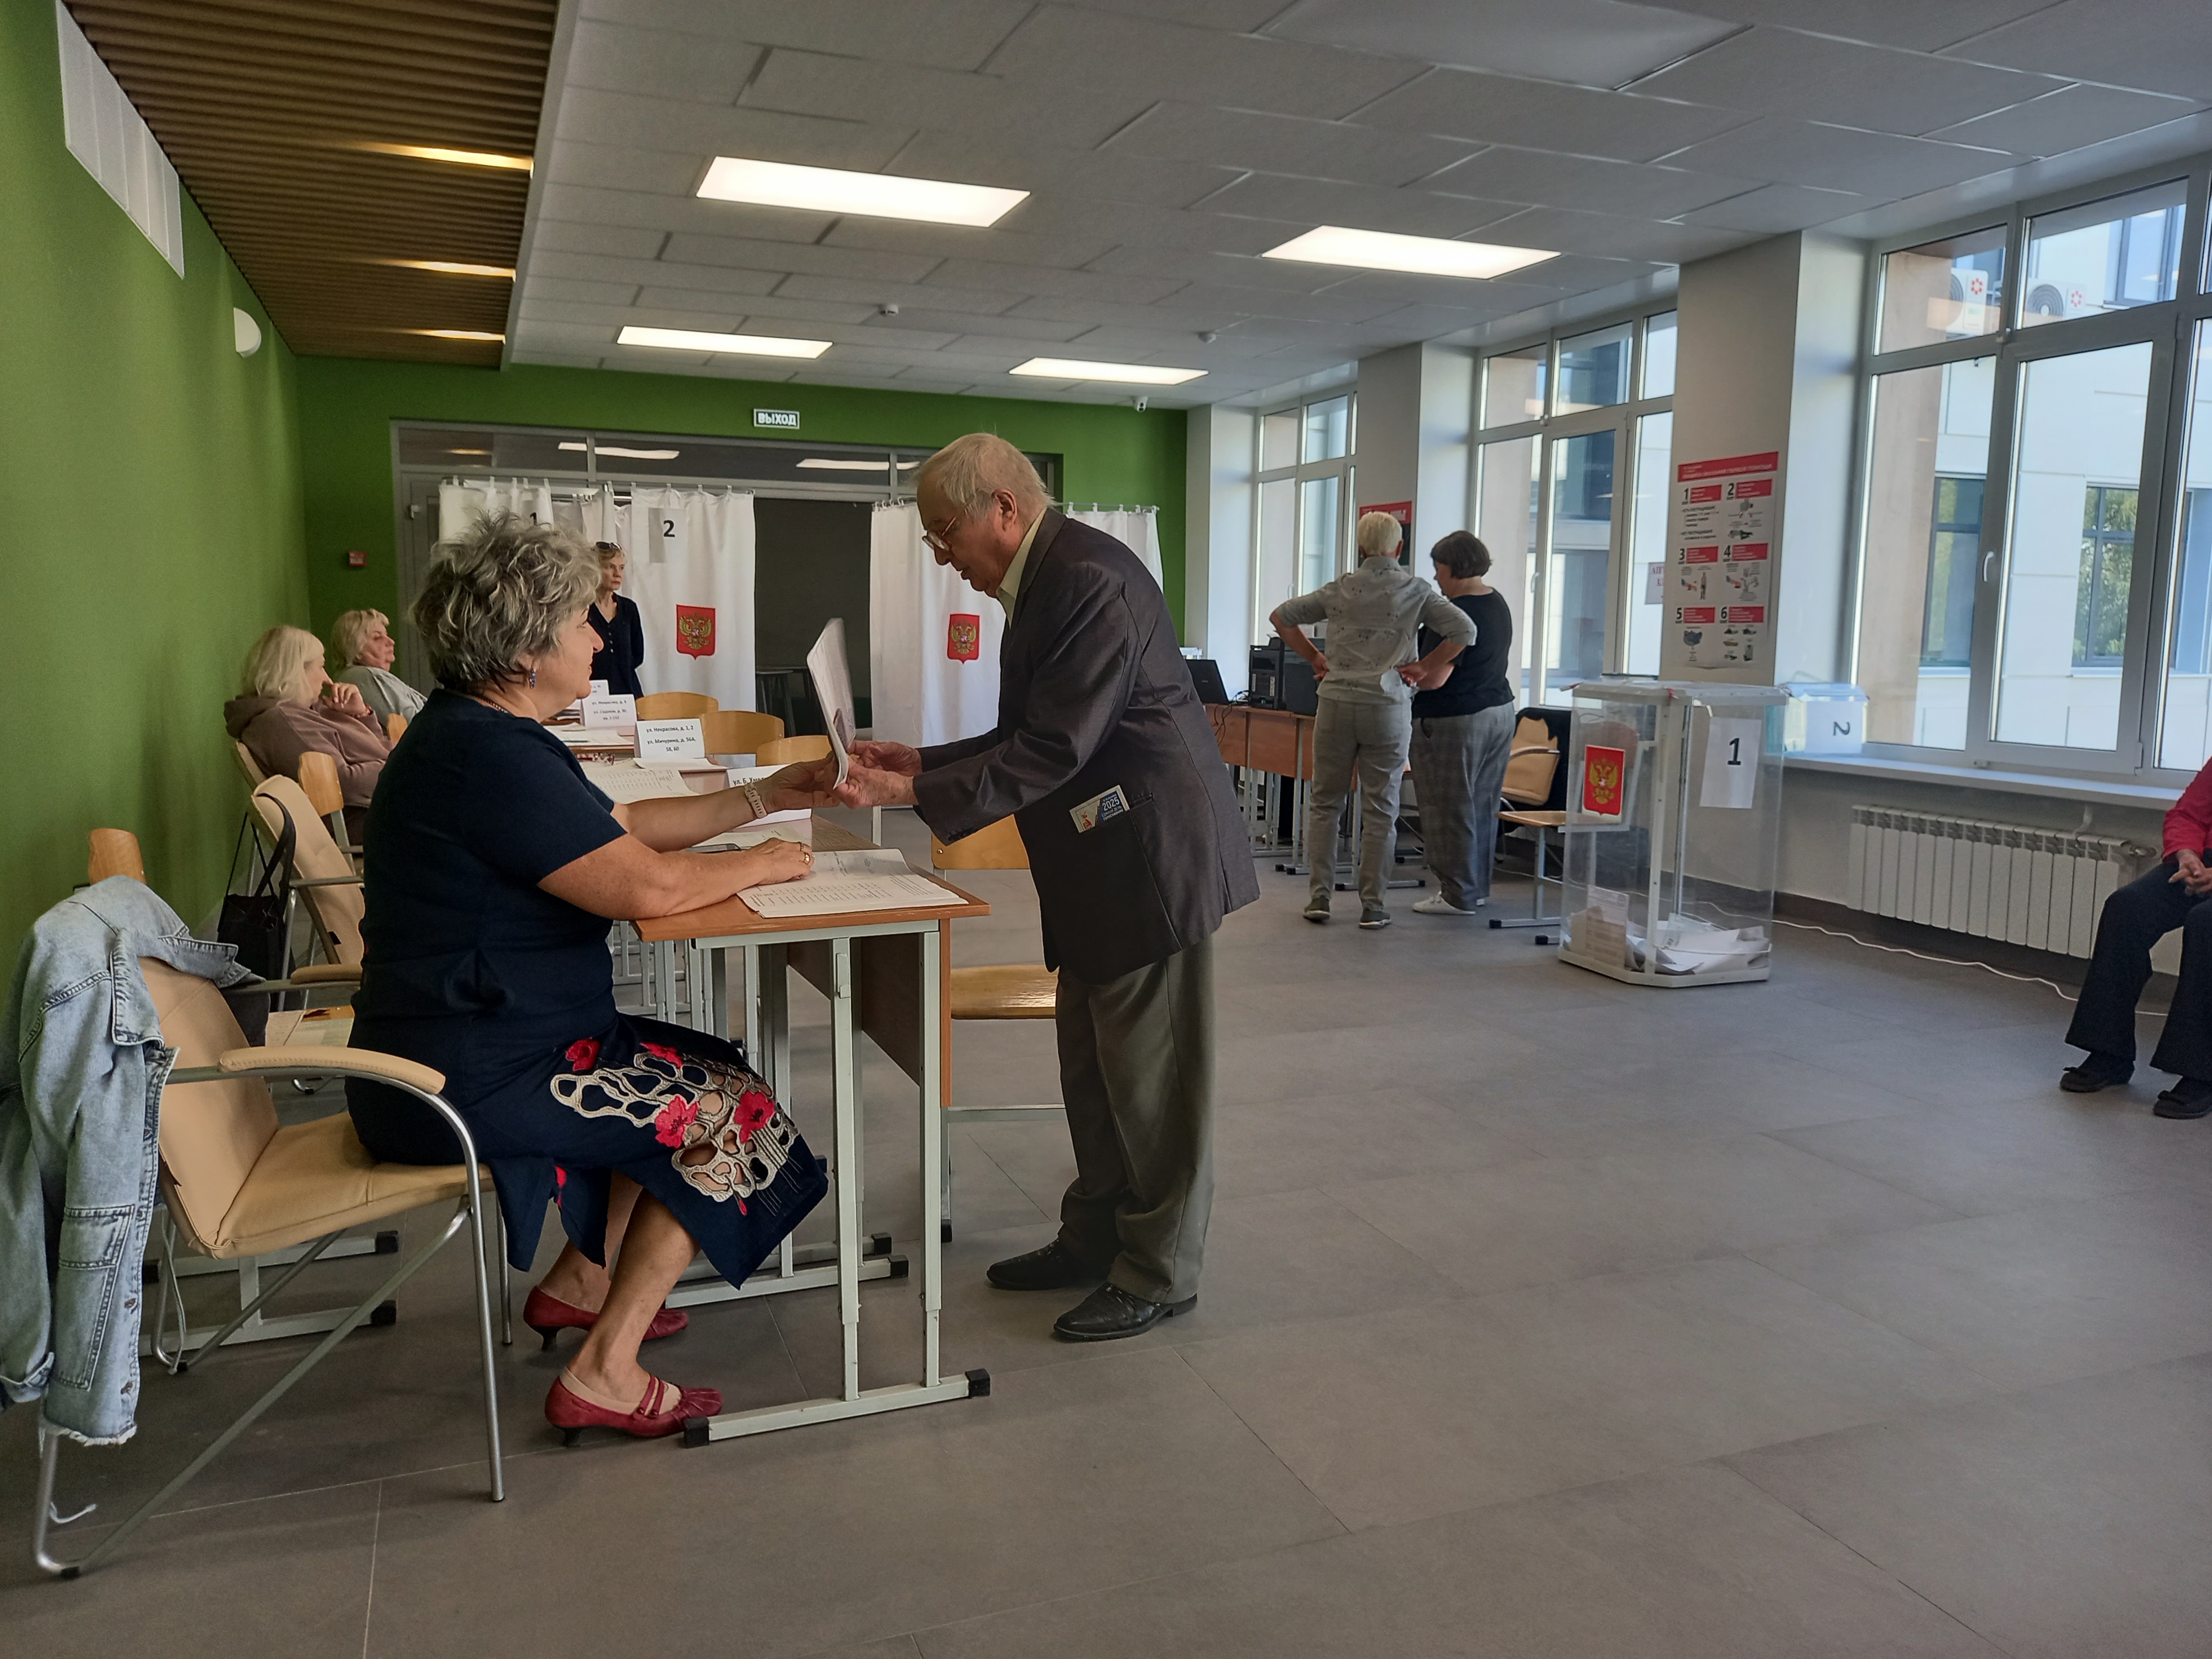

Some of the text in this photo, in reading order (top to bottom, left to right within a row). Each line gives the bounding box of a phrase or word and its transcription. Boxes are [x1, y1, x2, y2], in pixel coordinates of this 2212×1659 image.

[758, 412, 797, 426] ВЫХОД
[1684, 488, 1688, 500] 1
[1728, 482, 1734, 496] 2
[530, 512, 538, 526] 1
[663, 519, 676, 538] 2
[1679, 548, 1685, 561] 3
[1723, 545, 1731, 558] 4
[1676, 607, 1682, 619] 5
[1720, 606, 1728, 619] 6
[1833, 721, 1850, 737] 2
[1727, 737, 1741, 766] 1
[1102, 796, 1120, 812] 2025
